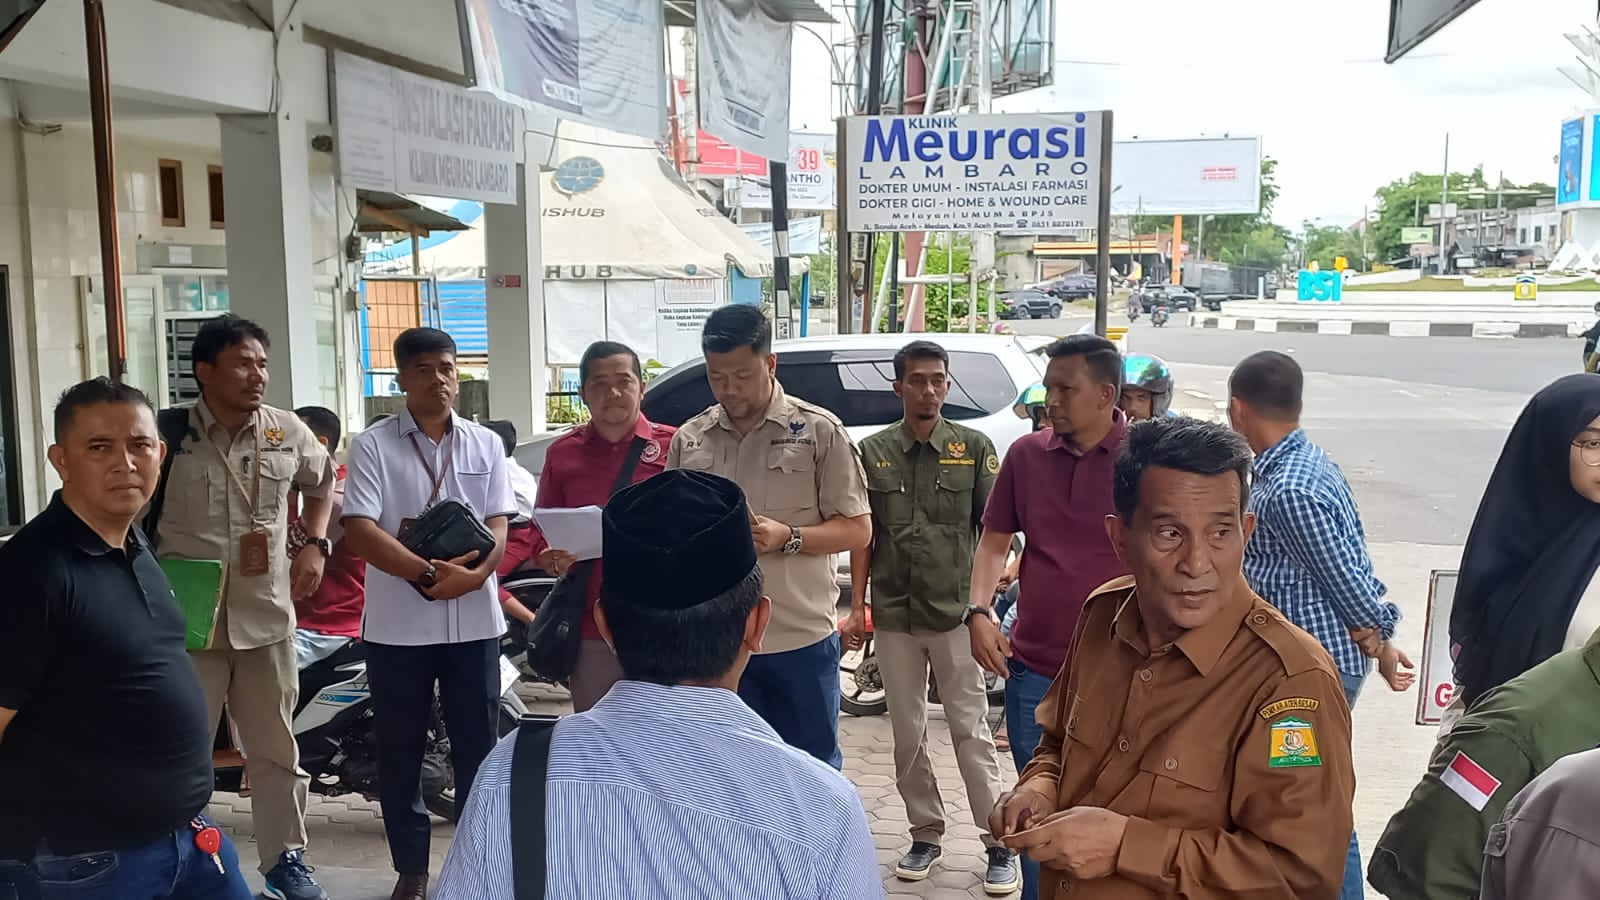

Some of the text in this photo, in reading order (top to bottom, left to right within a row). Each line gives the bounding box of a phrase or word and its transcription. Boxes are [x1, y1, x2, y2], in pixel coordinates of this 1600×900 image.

[466, 95, 515, 152] FARMASI
[908, 118, 958, 129] KLINIK
[863, 112, 1086, 163] Meurasi
[859, 162, 1088, 180] LAMBARO
[788, 174, 821, 184] NTHO
[859, 184, 908, 194] DOKTER
[912, 183, 952, 193] UMUM
[965, 181, 1028, 192] INSTALASI
[1032, 180, 1088, 190] FARMASI
[859, 199, 908, 209] DOKTER
[912, 198, 936, 208] GIGI
[947, 198, 985, 208] HOME
[988, 198, 996, 207] &
[1000, 196, 1050, 206] WOUND
[1054, 195, 1087, 205] CARE
[541, 208, 606, 217] ISHUB
[961, 211, 1002, 219] UMUM
[1022, 210, 1054, 218] BPJS
[1298, 270, 1341, 301] BSI
[1435, 683, 1453, 708] G
